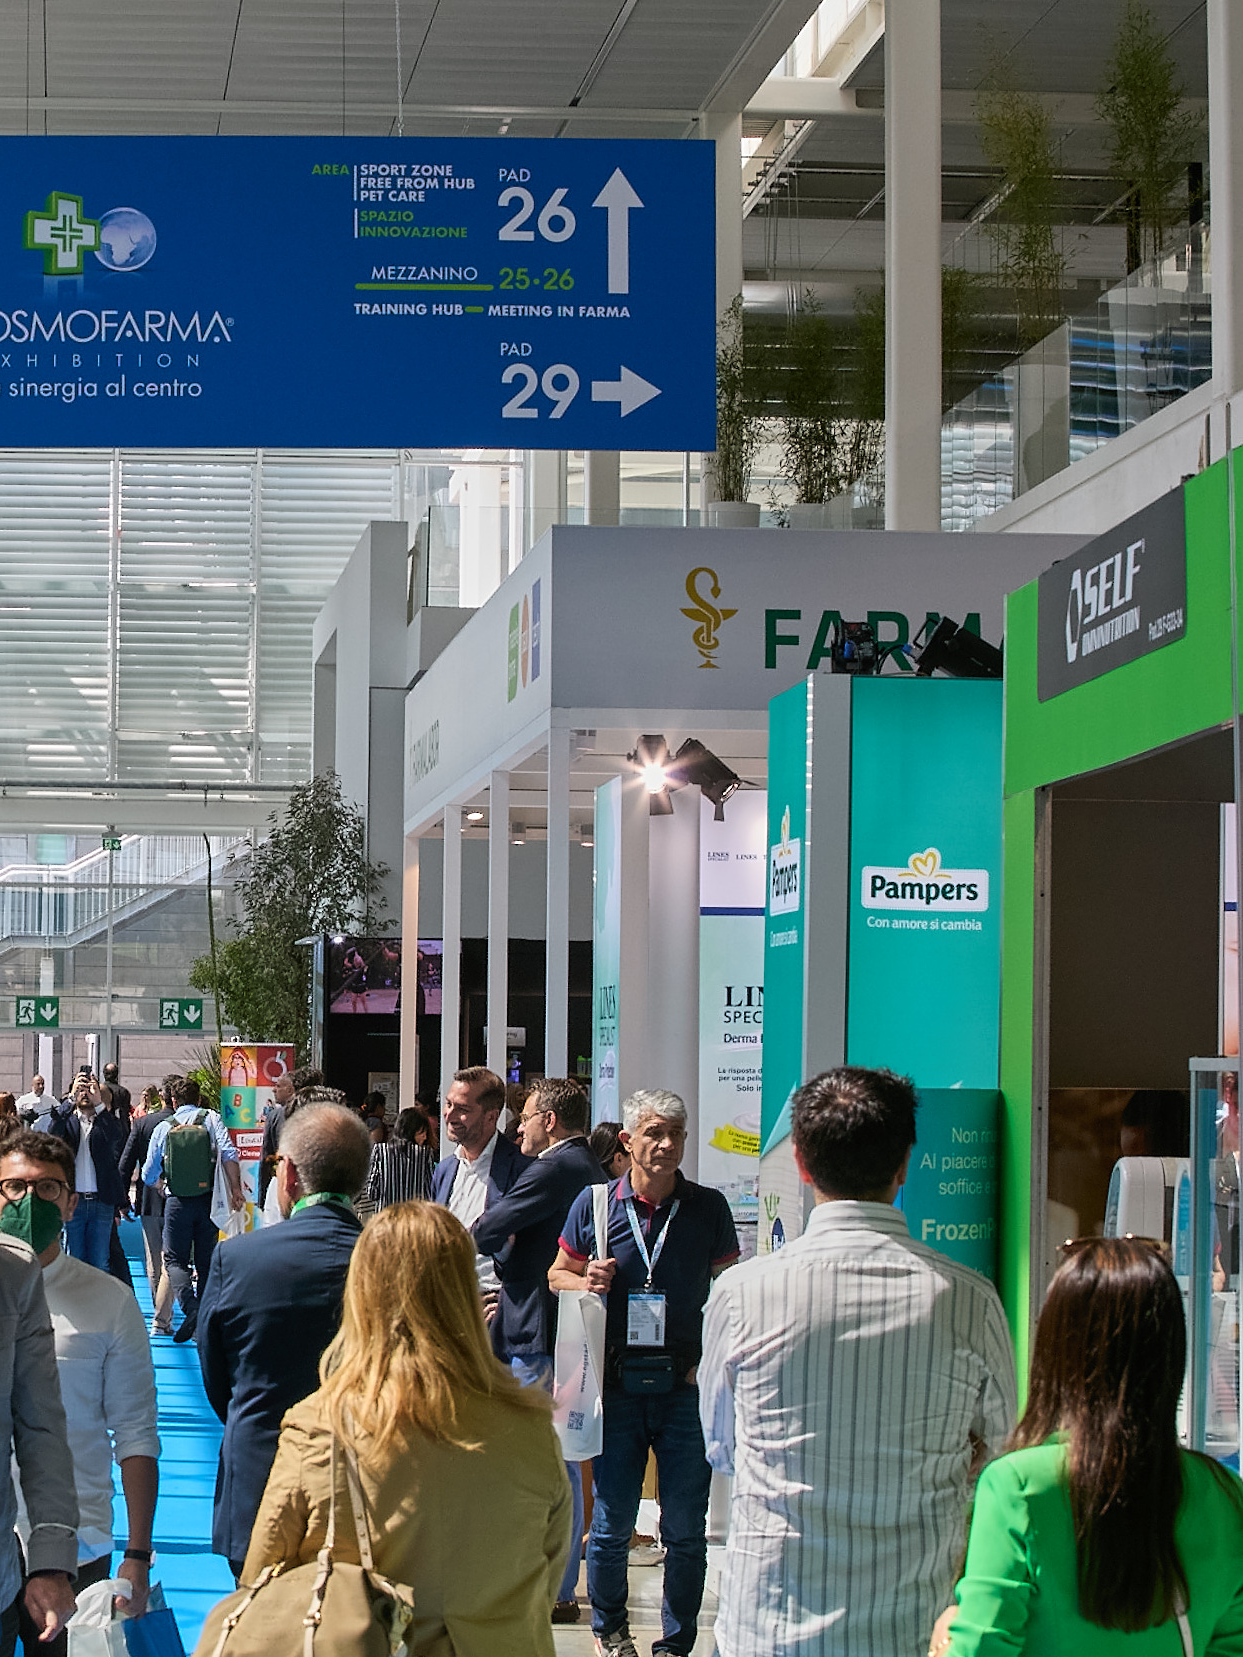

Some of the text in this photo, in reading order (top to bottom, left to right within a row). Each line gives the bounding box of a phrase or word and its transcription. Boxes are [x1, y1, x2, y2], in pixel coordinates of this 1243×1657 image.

[312, 165, 453, 176] AREA SPORT ZONE
[499, 169, 530, 182] PAD
[360, 178, 475, 189] FREE FROM HUB
[360, 191, 425, 202] PET CARE
[360, 211, 414, 222] SPAZIO
[498, 187, 576, 243] 26
[360, 226, 468, 238] INNOVAZIONE
[371, 266, 478, 281] MEZZANINO
[354, 303, 464, 316] TRAINING HUB
[488, 305, 630, 318] MEETING IN FARMA
[500, 342, 532, 356] PAD
[9, 378, 97, 402] sinergia
[106, 374, 125, 396] al
[133, 378, 202, 397] centro
[501, 363, 580, 418] 29
[871, 875, 978, 905] Pampers
[867, 916, 982, 931] Con amore si cambia
[725, 986, 764, 1007] LI
[724, 1011, 762, 1023] SPEC
[724, 1033, 757, 1043] Derma
[728, 1067, 756, 1075] risposta
[737, 1084, 754, 1092] Solo
[952, 1127, 977, 1143] Non
[920, 1152, 936, 1169] Al
[942, 1152, 987, 1172] piacere
[939, 1178, 982, 1195] soffice
